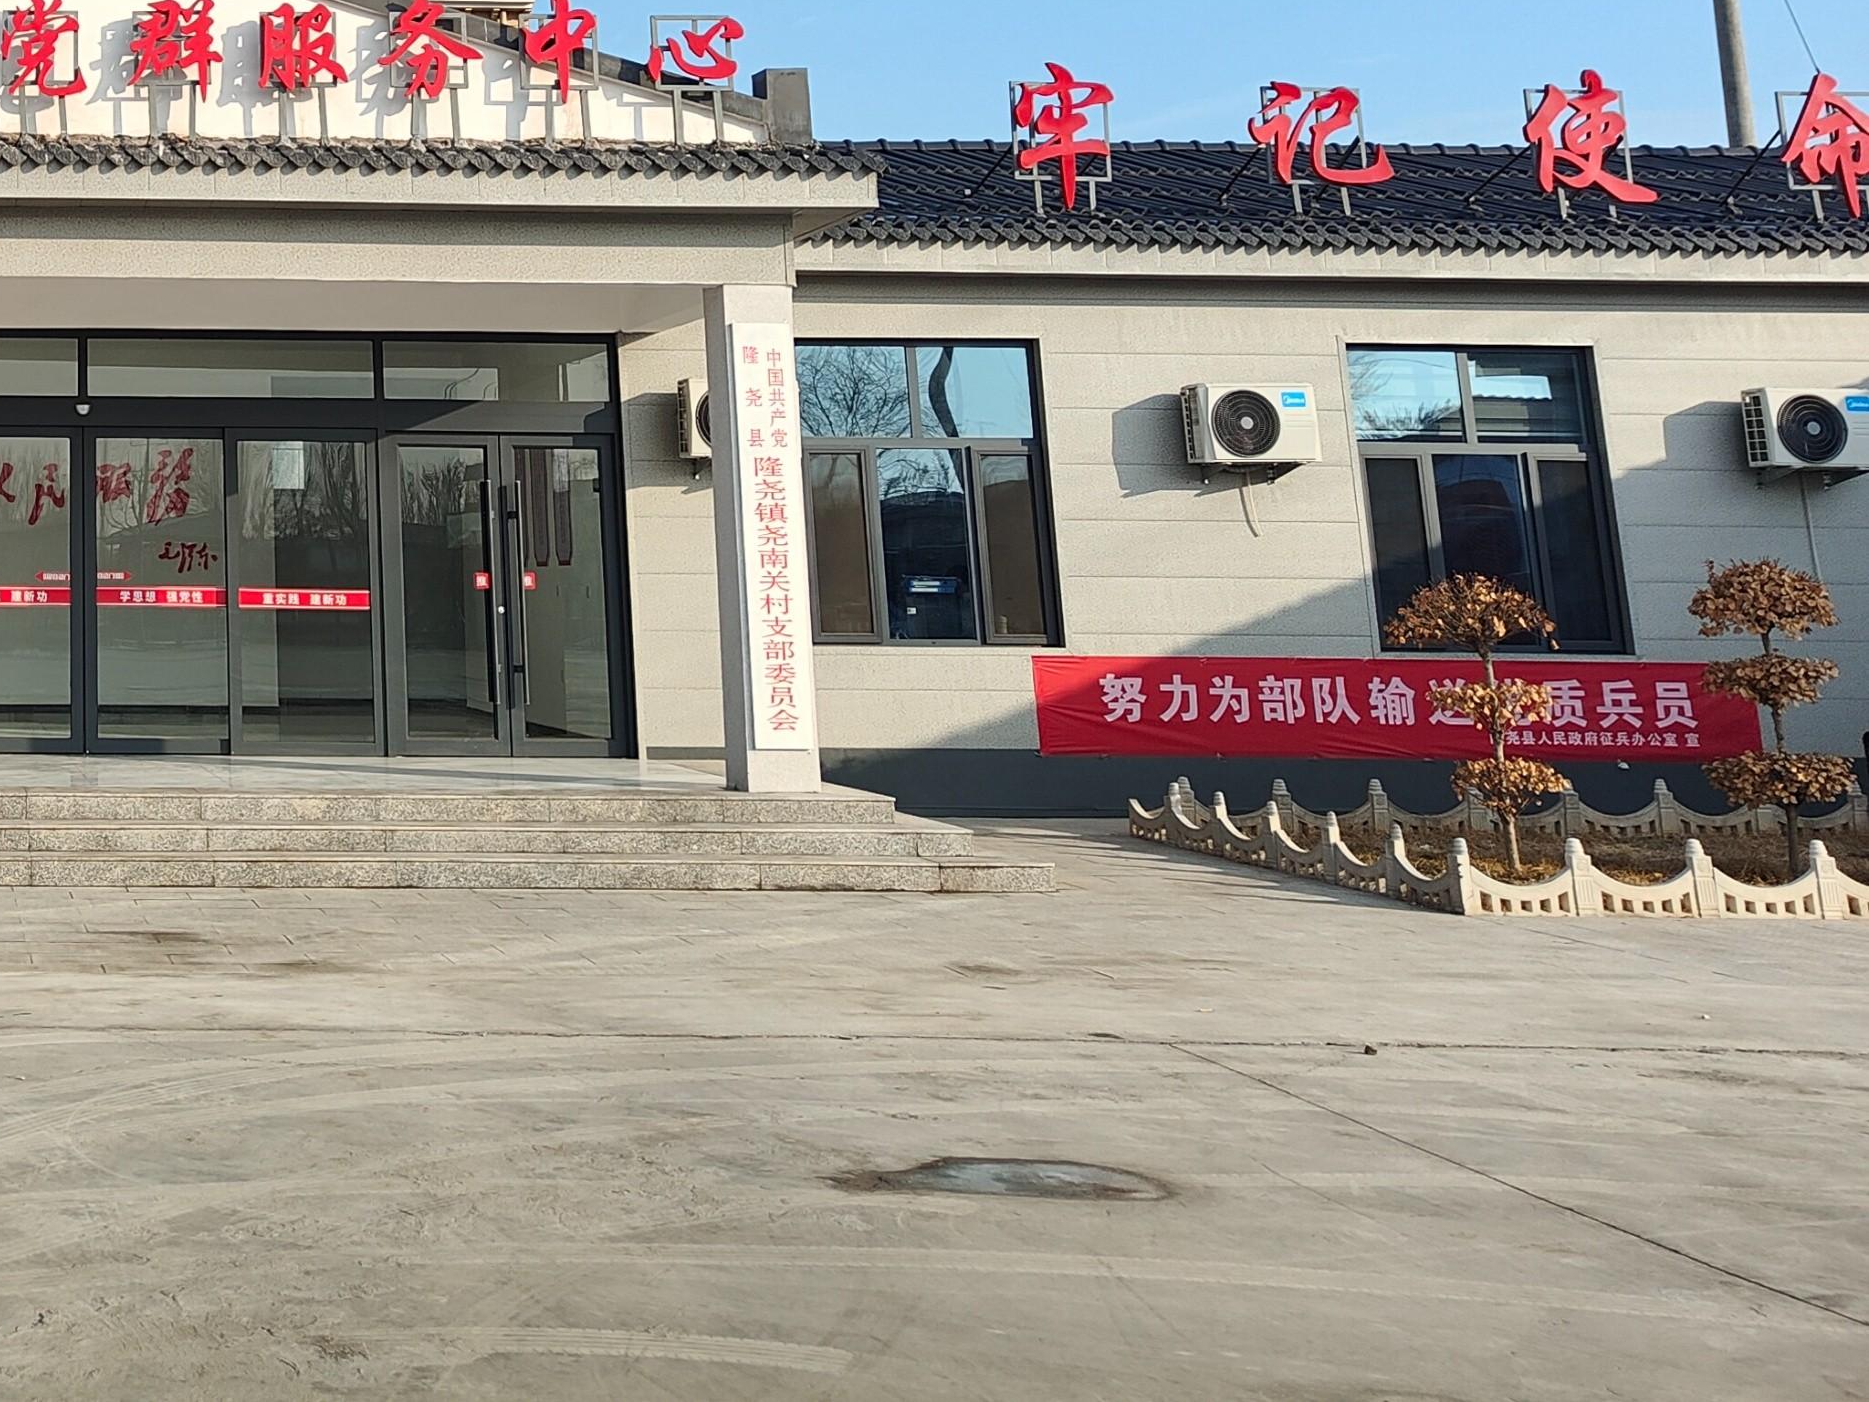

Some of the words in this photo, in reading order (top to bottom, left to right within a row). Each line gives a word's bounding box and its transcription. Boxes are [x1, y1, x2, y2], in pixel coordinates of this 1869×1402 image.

[1014, 63, 1869, 218] 牢记使命
[742, 345, 765, 448] 隆尧县
[766, 348, 789, 448] 中国共产党
[11, 590, 48, 603] 建新功
[119, 590, 157, 604] 学思想
[310, 593, 347, 606] 建新功
[753, 456, 799, 732] 隆尧镇尧南关村支部委员会
[1098, 673, 1699, 729] 努力为部队输送质兵员
[1489, 730, 1679, 747] 尧县人民政府征兵办公室
[1685, 732, 1700, 747] 宣
